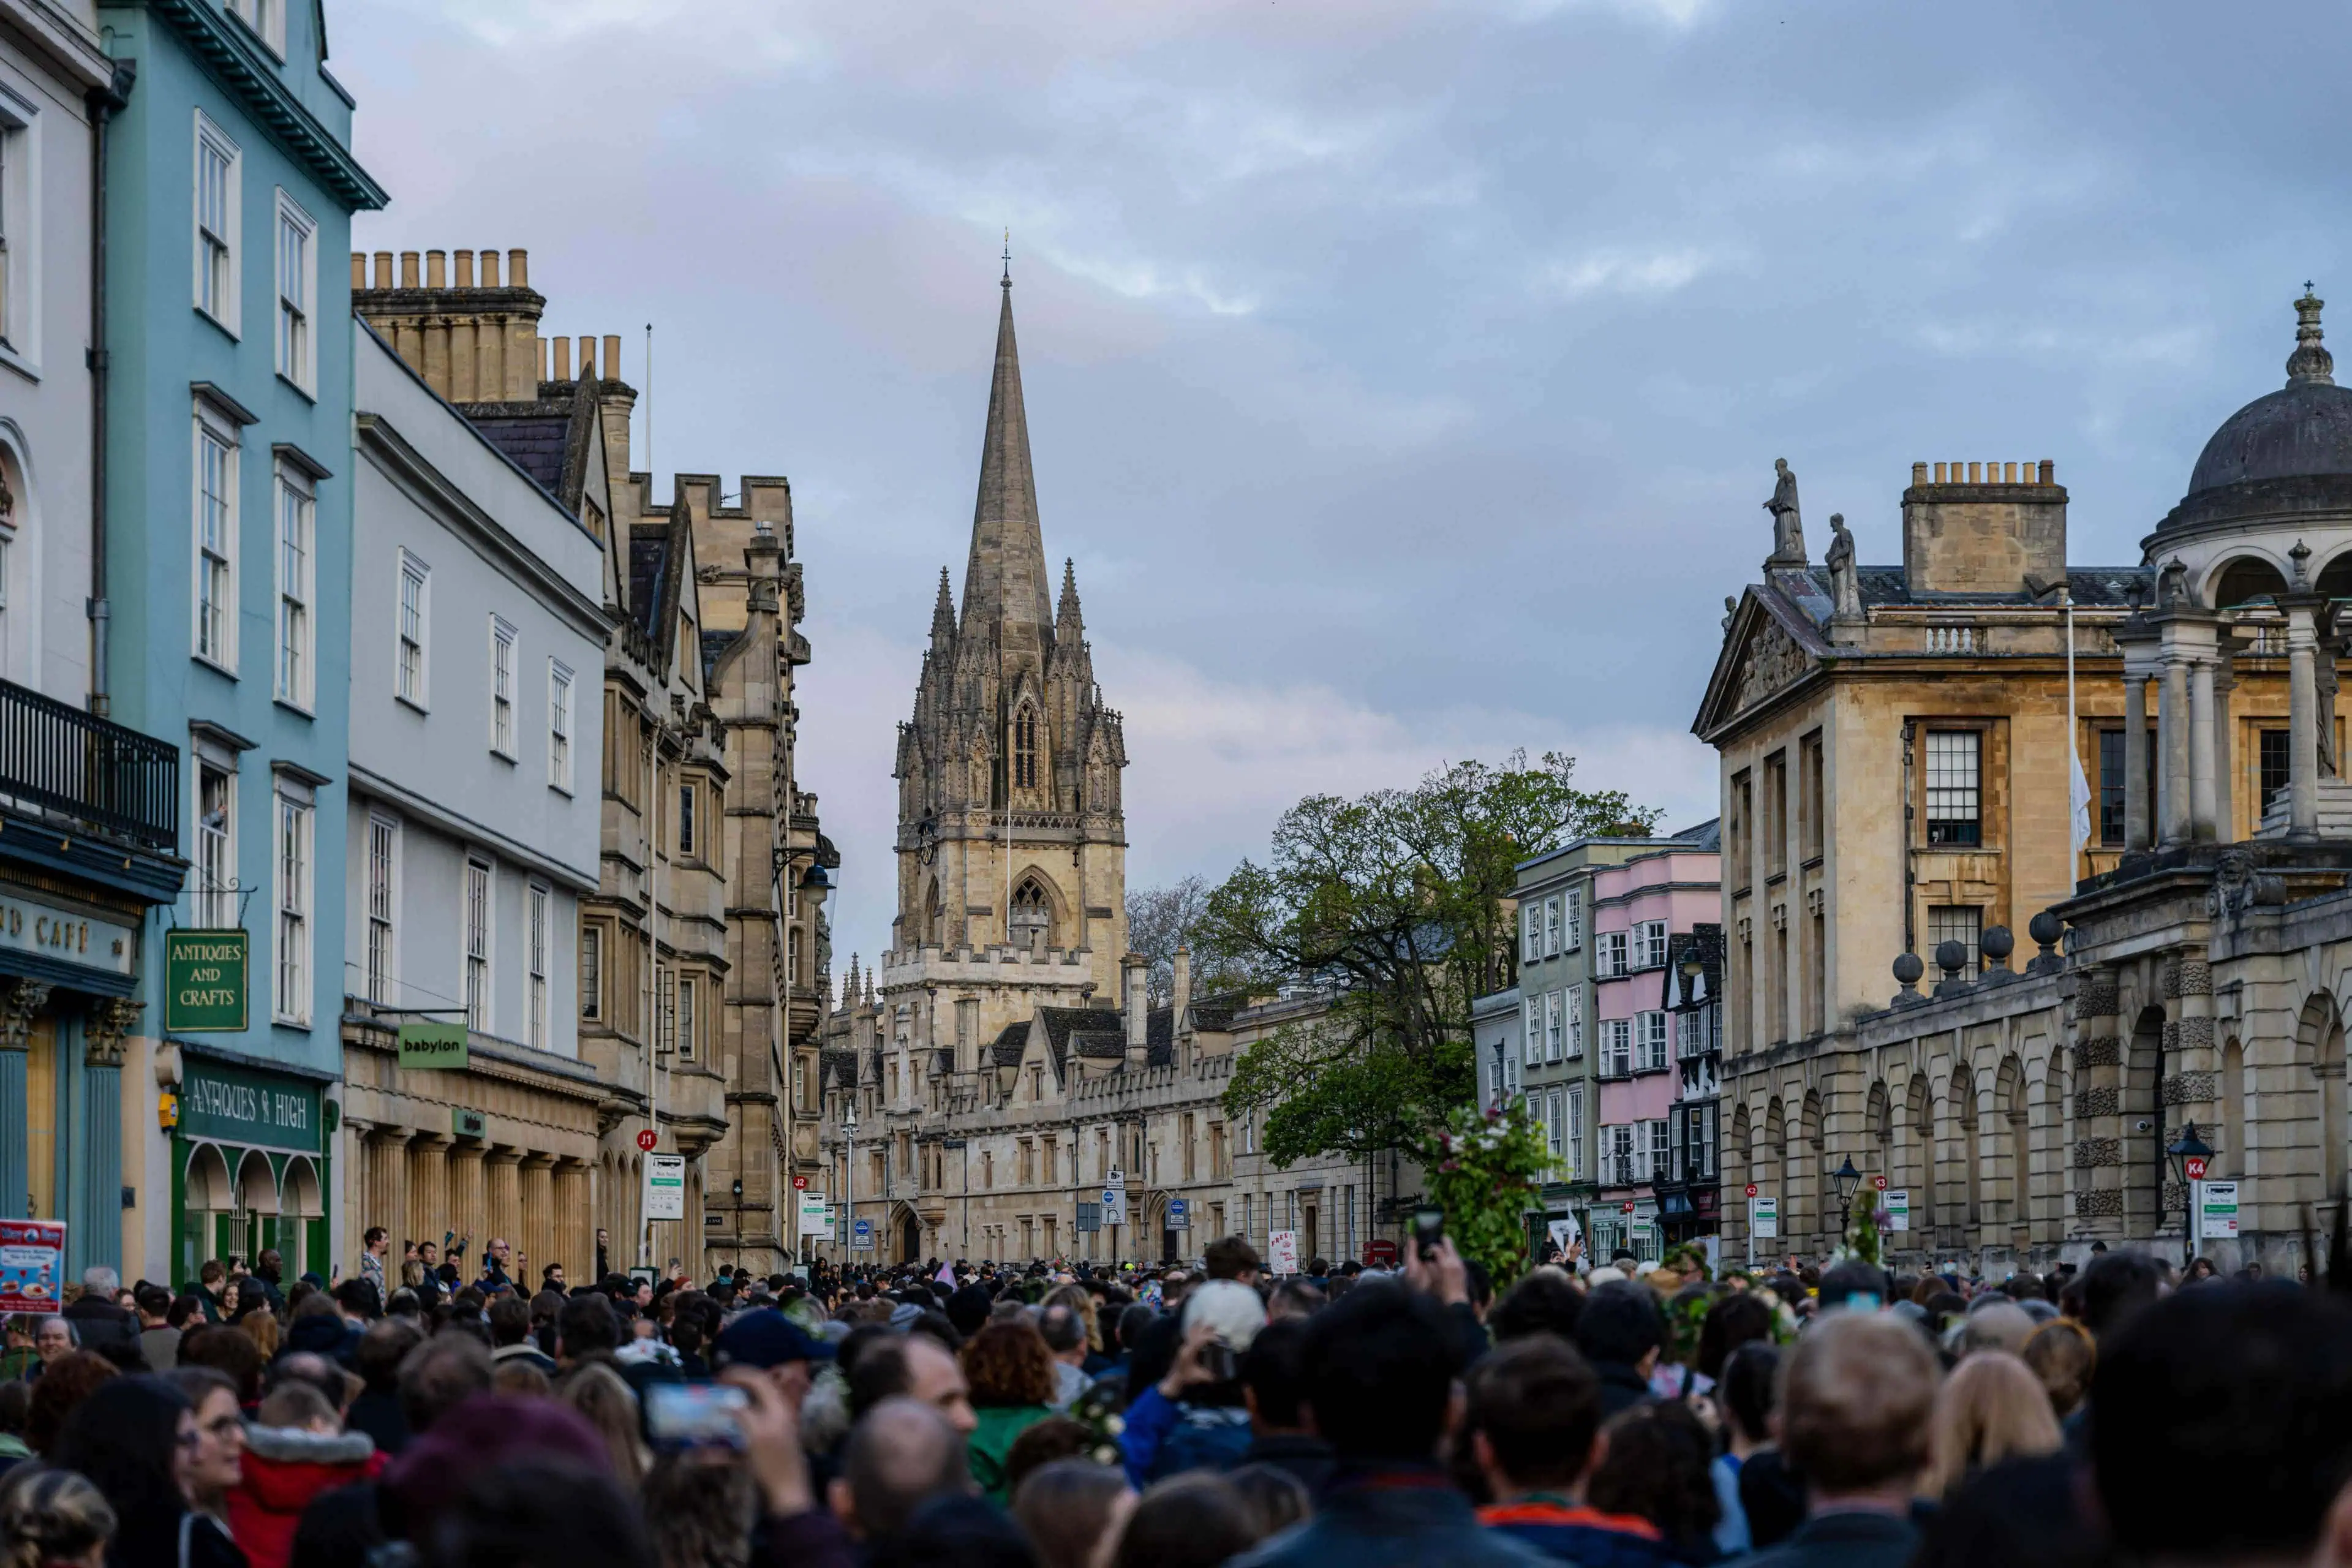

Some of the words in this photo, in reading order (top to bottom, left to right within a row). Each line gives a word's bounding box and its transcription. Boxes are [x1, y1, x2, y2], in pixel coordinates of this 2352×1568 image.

[36, 916, 88, 953] CAFÉ
[172, 944, 241, 962] ANTIQUES
[190, 968, 221, 982] AND
[180, 990, 235, 1006] CRAFTS
[404, 1039, 459, 1054] babylon
[192, 1077, 255, 1121] ANTIQUES
[276, 1093, 306, 1129] HIGH
[641, 1134, 652, 1145] J1
[2188, 1163, 2204, 1174] K4
